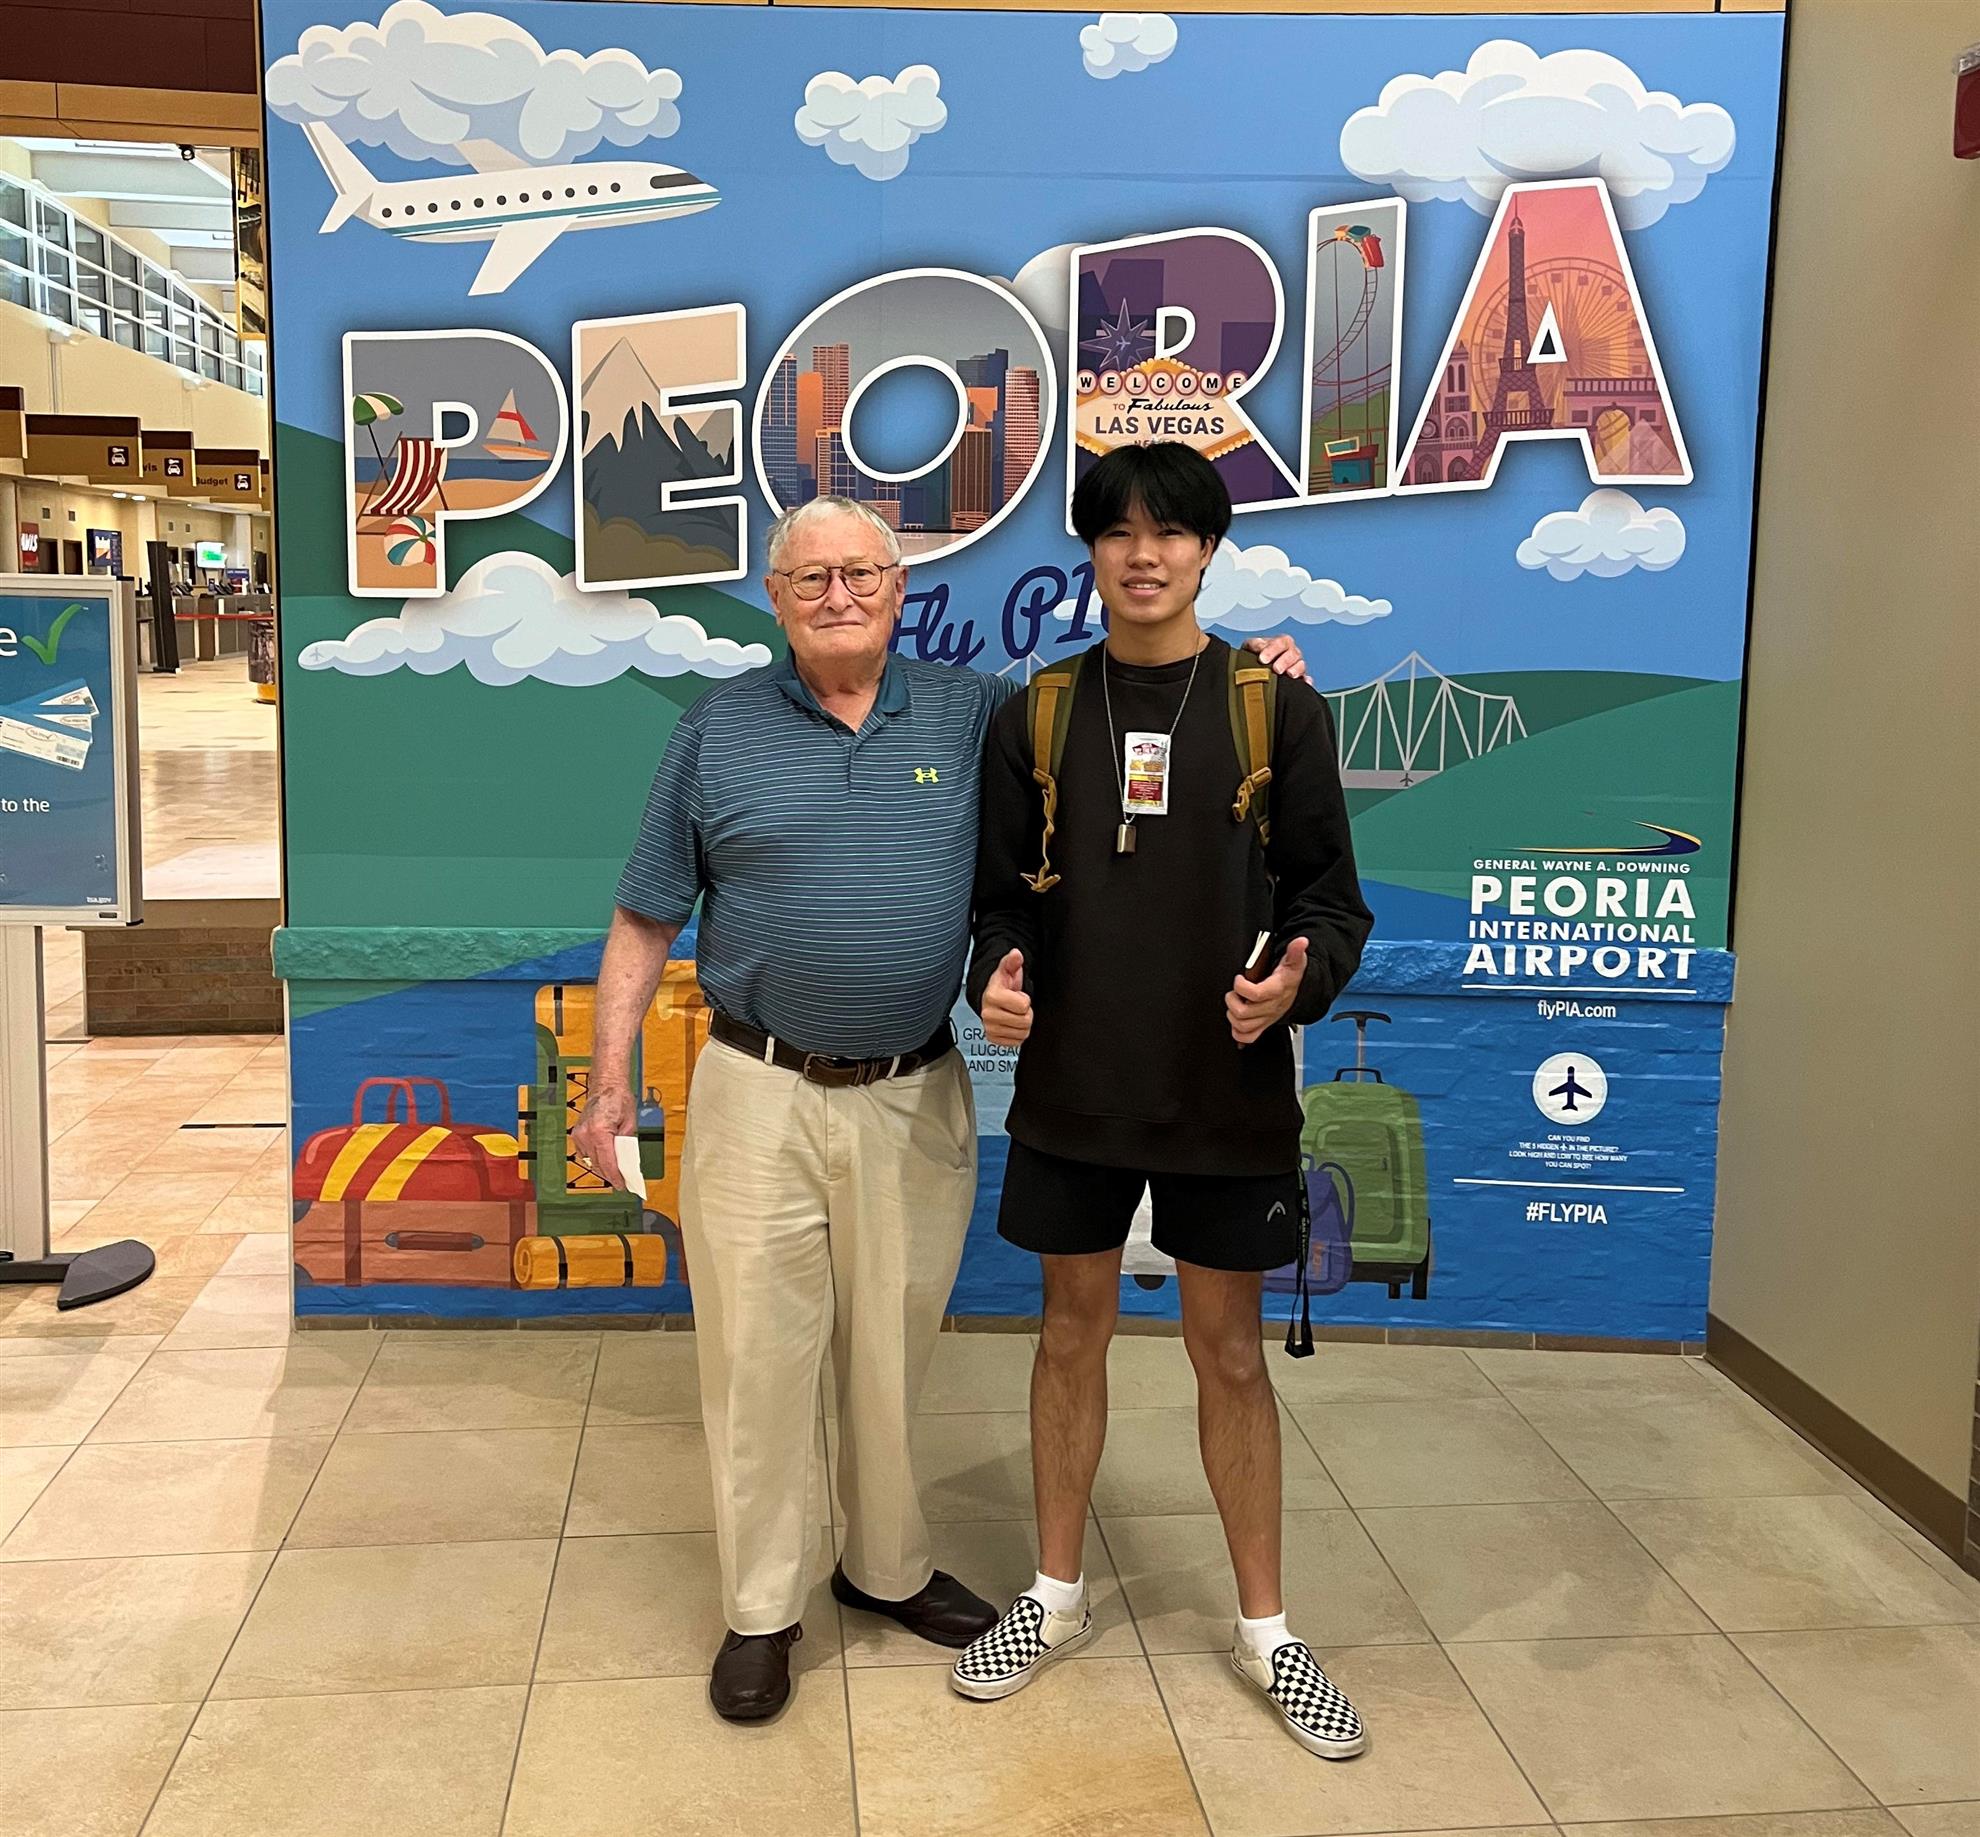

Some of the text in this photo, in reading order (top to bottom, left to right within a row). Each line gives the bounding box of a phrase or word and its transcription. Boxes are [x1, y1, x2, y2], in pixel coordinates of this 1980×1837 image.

[342, 177, 1694, 600] PEORIA
[1080, 376, 1242, 389] WELCOME
[1113, 398, 1214, 414] TO Fabulous
[1095, 416, 1225, 435] LAS VEGAS
[143, 462, 158, 472] vis
[1001, 560, 1110, 660] PI
[1, 797, 50, 812] to the
[1473, 859, 1691, 874] GENERAL WAYNE A. DOWNING
[1471, 875, 1696, 919] PEORIA
[1468, 920, 1695, 943] INTERNATIONAL
[1462, 943, 1697, 979] AIRPORT
[1537, 1000, 1617, 1020] flyPIA.com
[968, 1060, 995, 1072] AND
[1547, 1134, 1561, 1142] CAN
[1526, 1202, 1608, 1224] #FLYPIA
